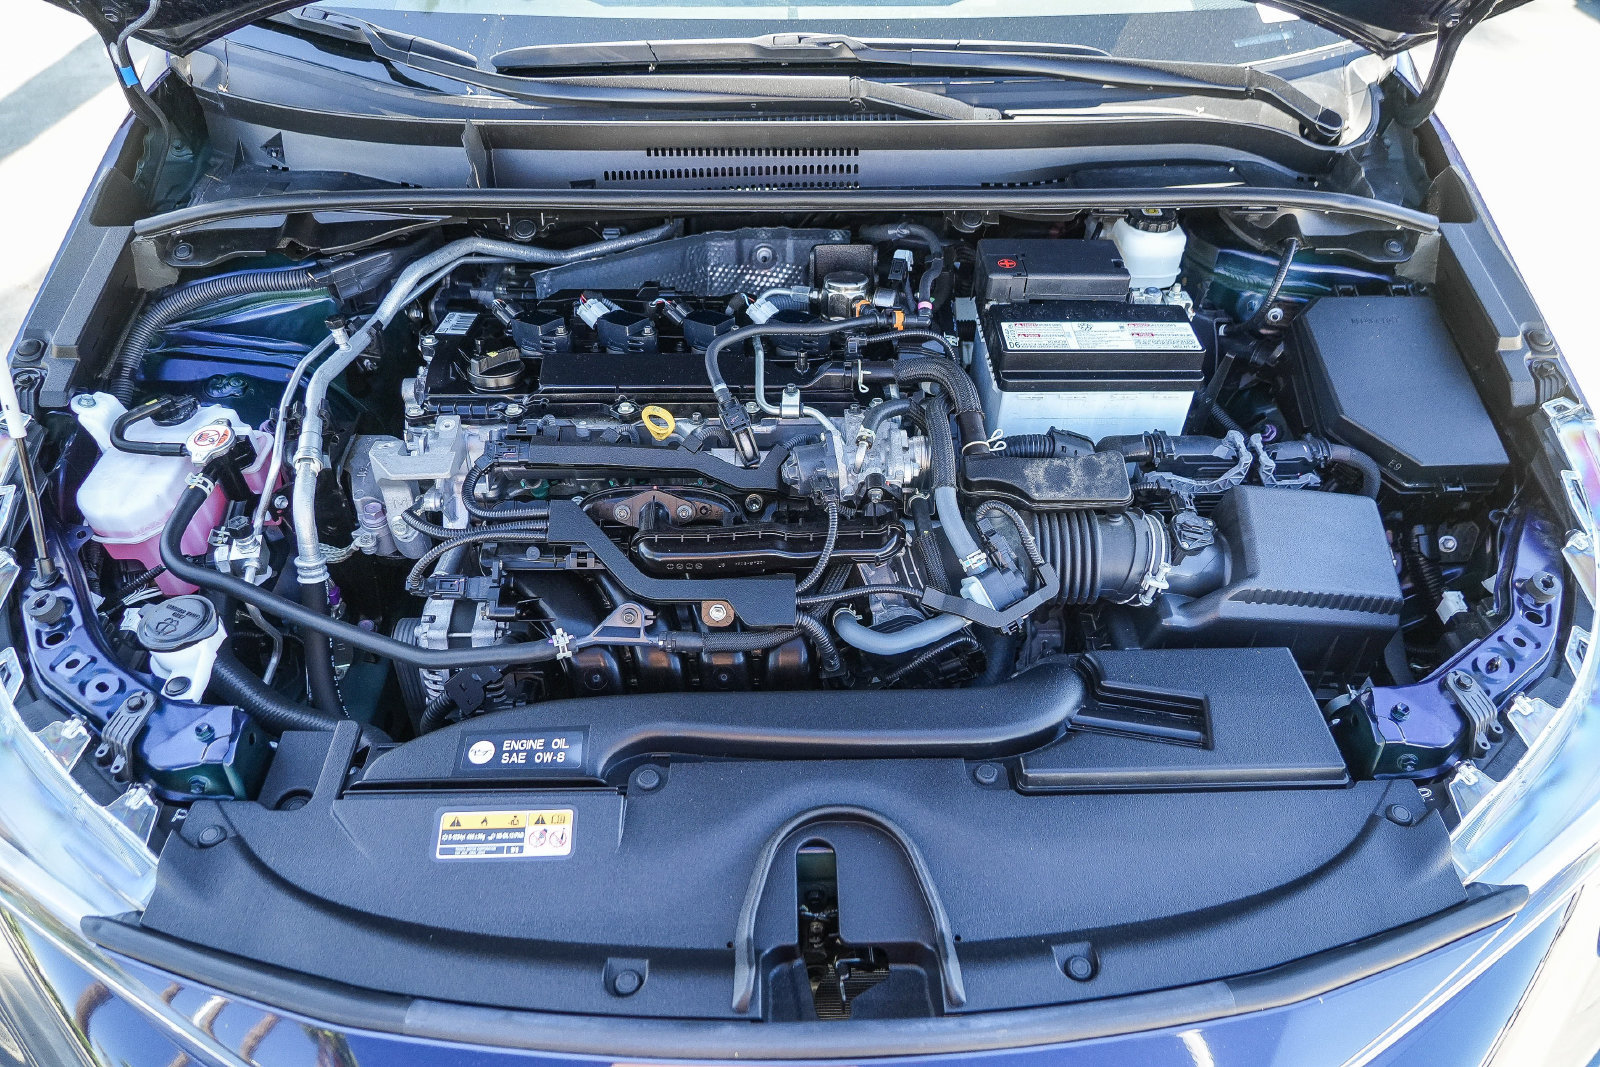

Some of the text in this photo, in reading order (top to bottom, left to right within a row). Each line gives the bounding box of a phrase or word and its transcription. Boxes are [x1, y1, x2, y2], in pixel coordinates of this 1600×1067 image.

[503, 737, 570, 750] ENGINE OIL
[501, 752, 527, 764] SAE
